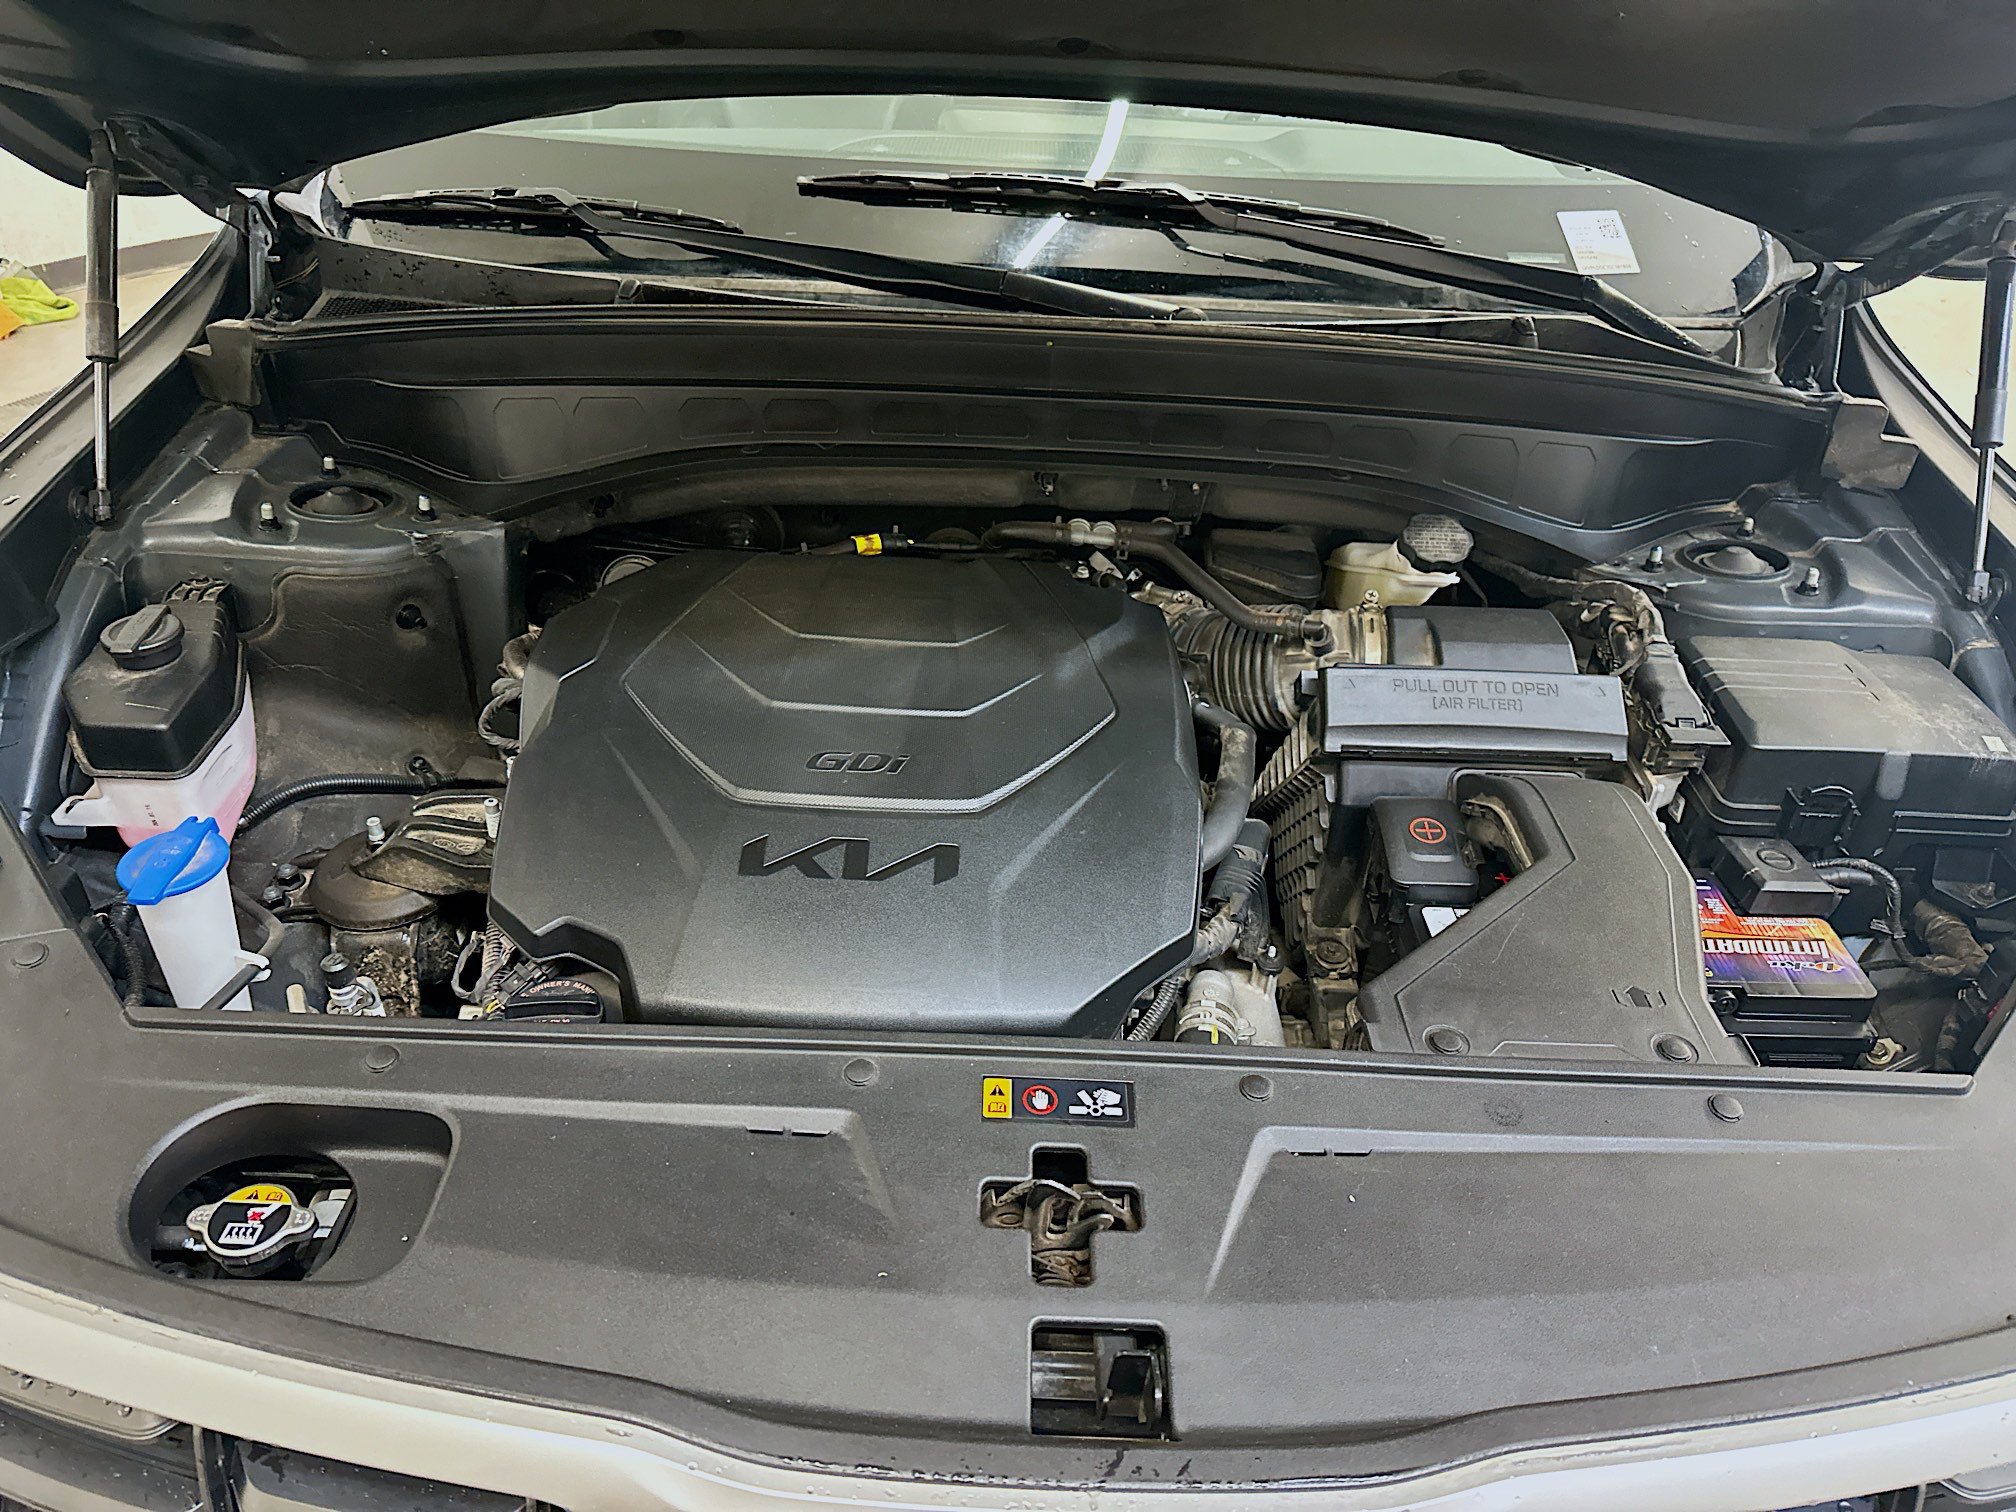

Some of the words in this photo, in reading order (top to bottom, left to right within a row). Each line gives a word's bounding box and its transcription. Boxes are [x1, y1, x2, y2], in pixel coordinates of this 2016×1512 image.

[1393, 678, 1438, 693] PULL
[1443, 679, 1481, 694] OUT
[1483, 680, 1506, 695] TO
[1512, 681, 1559, 697] OPEN
[805, 751, 911, 775] GDi
[737, 834, 961, 886] KIA
[1701, 938, 1831, 959] INTIMIDAT
[529, 980, 571, 995] OWNER'S
[572, 981, 596, 995] MAN
